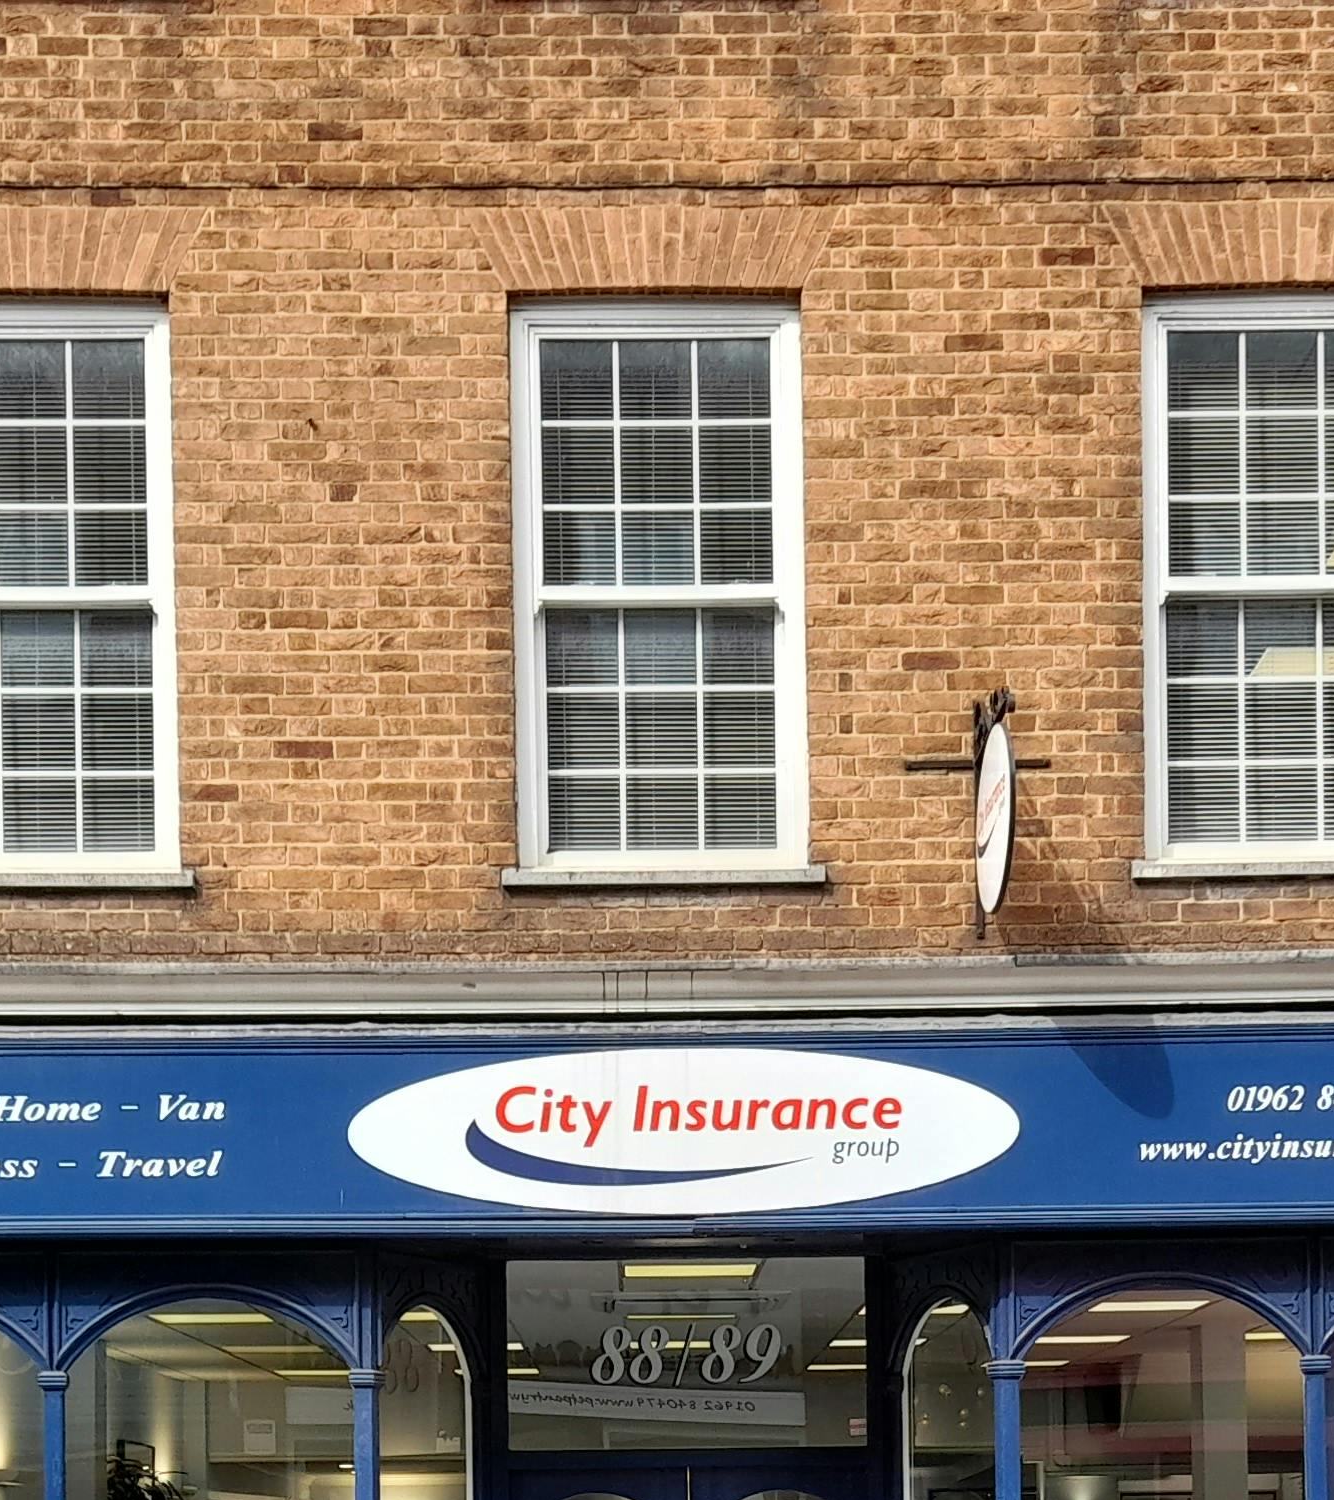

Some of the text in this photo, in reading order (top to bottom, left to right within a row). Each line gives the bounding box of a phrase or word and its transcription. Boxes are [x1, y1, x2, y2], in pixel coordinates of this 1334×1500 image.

[158, 1094, 226, 1121] Van
[1227, 1085, 1306, 1112] 01962
[495, 1085, 903, 1147] City Insurance
[96, 1150, 224, 1179] Travel
[833, 1137, 901, 1164] group
[590, 1322, 783, 1389] 88/89
